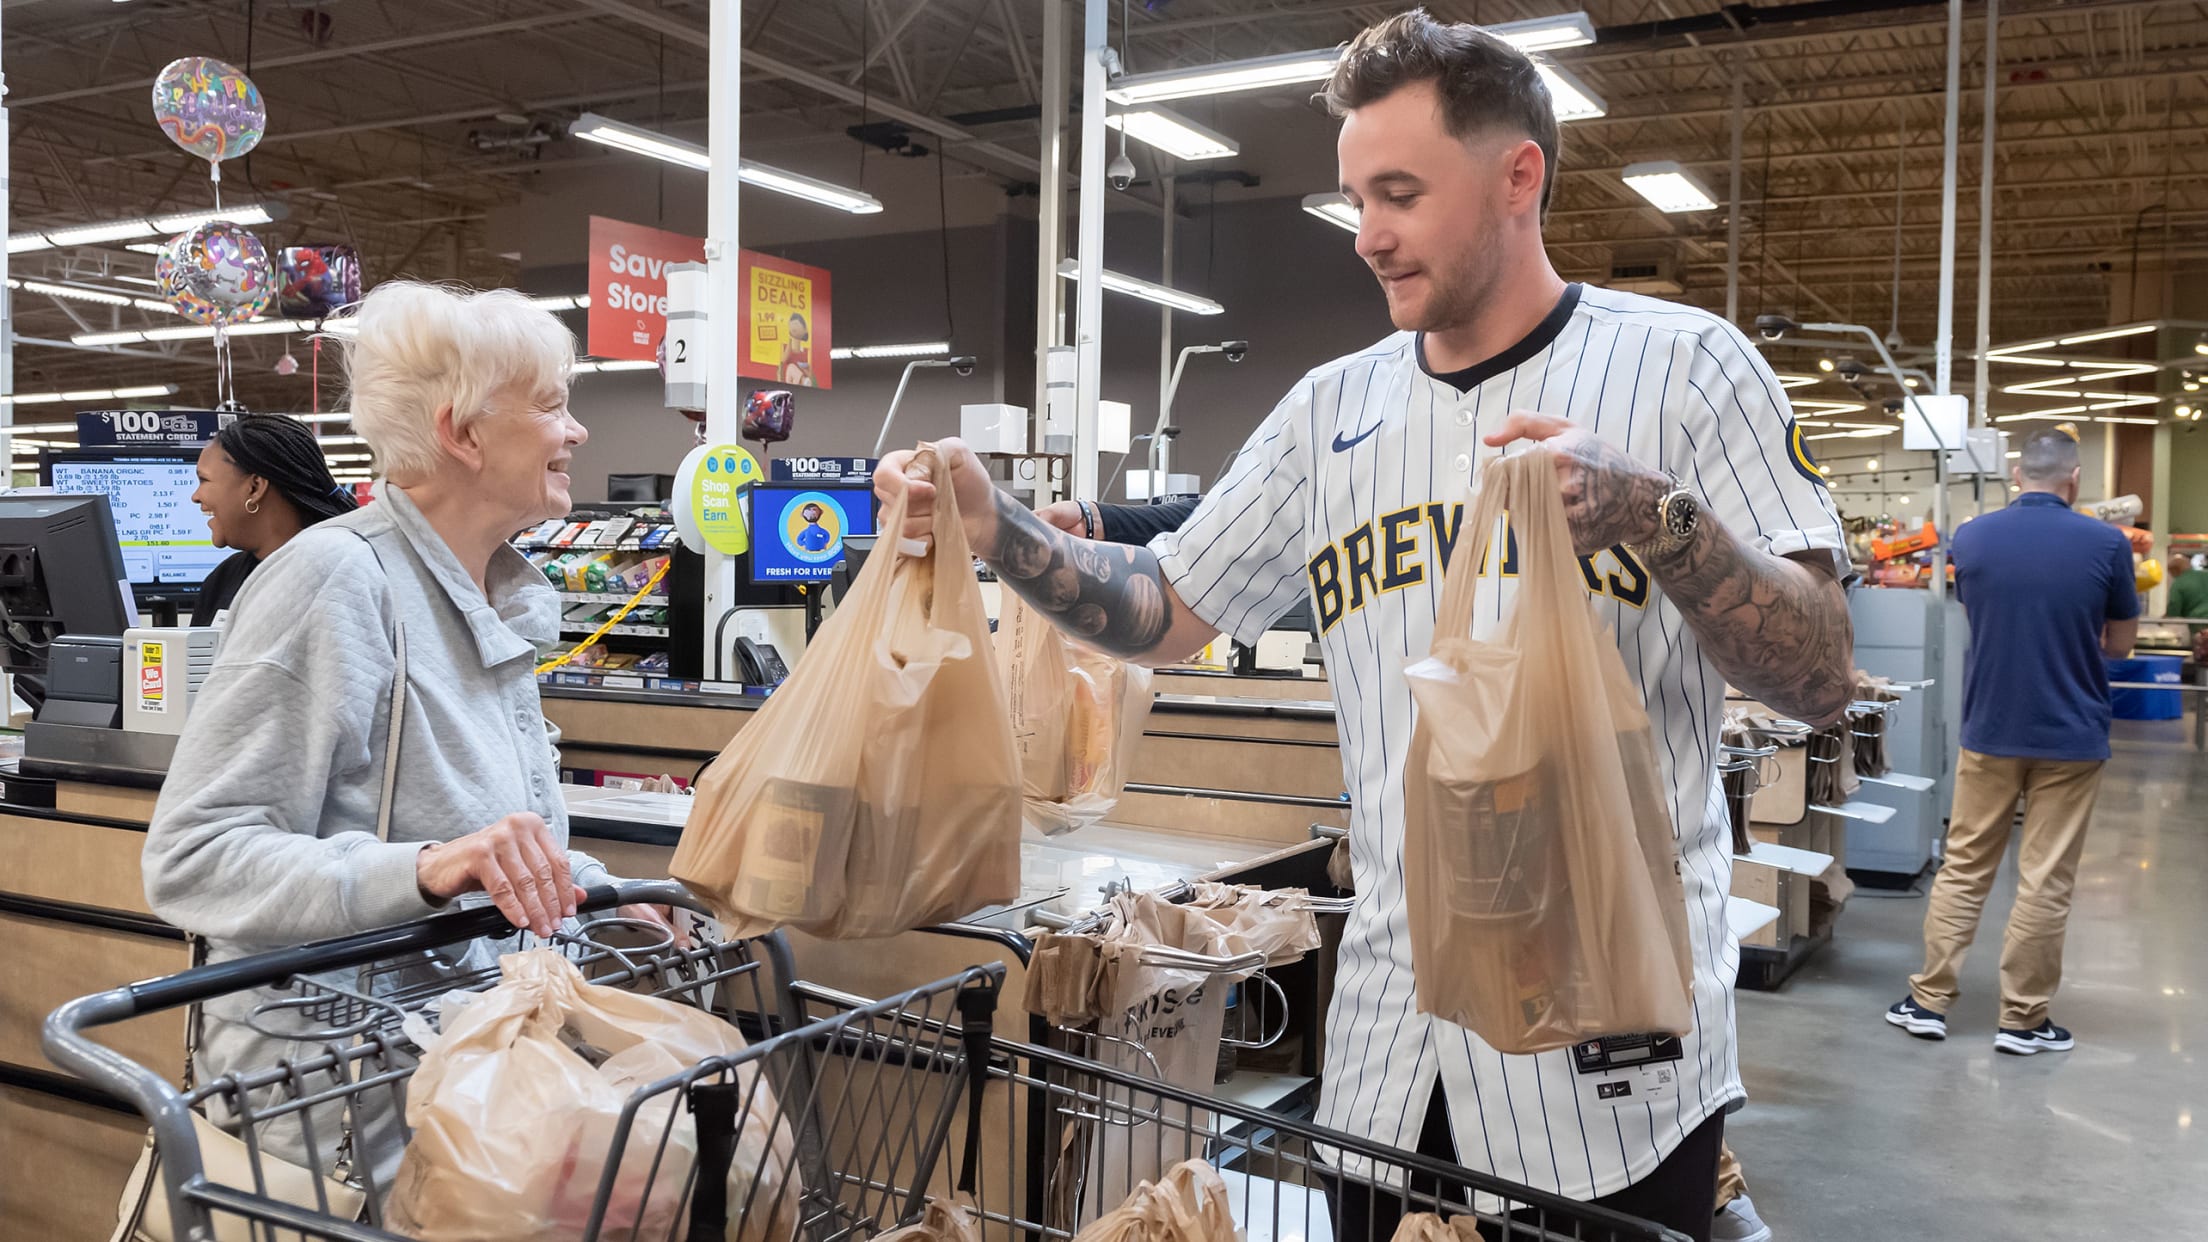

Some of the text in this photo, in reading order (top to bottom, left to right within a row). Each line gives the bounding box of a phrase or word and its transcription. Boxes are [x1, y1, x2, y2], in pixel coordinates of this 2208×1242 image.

[758, 272, 805, 293] SIZZLING
[758, 286, 806, 310] DEALS
[674, 339, 687, 363] 2
[101, 412, 160, 433] $100
[116, 433, 198, 441] STATEMENT CREDIT
[785, 458, 820, 472] $100
[766, 567, 792, 576] FRESH
[793, 567, 811, 576] FOR
